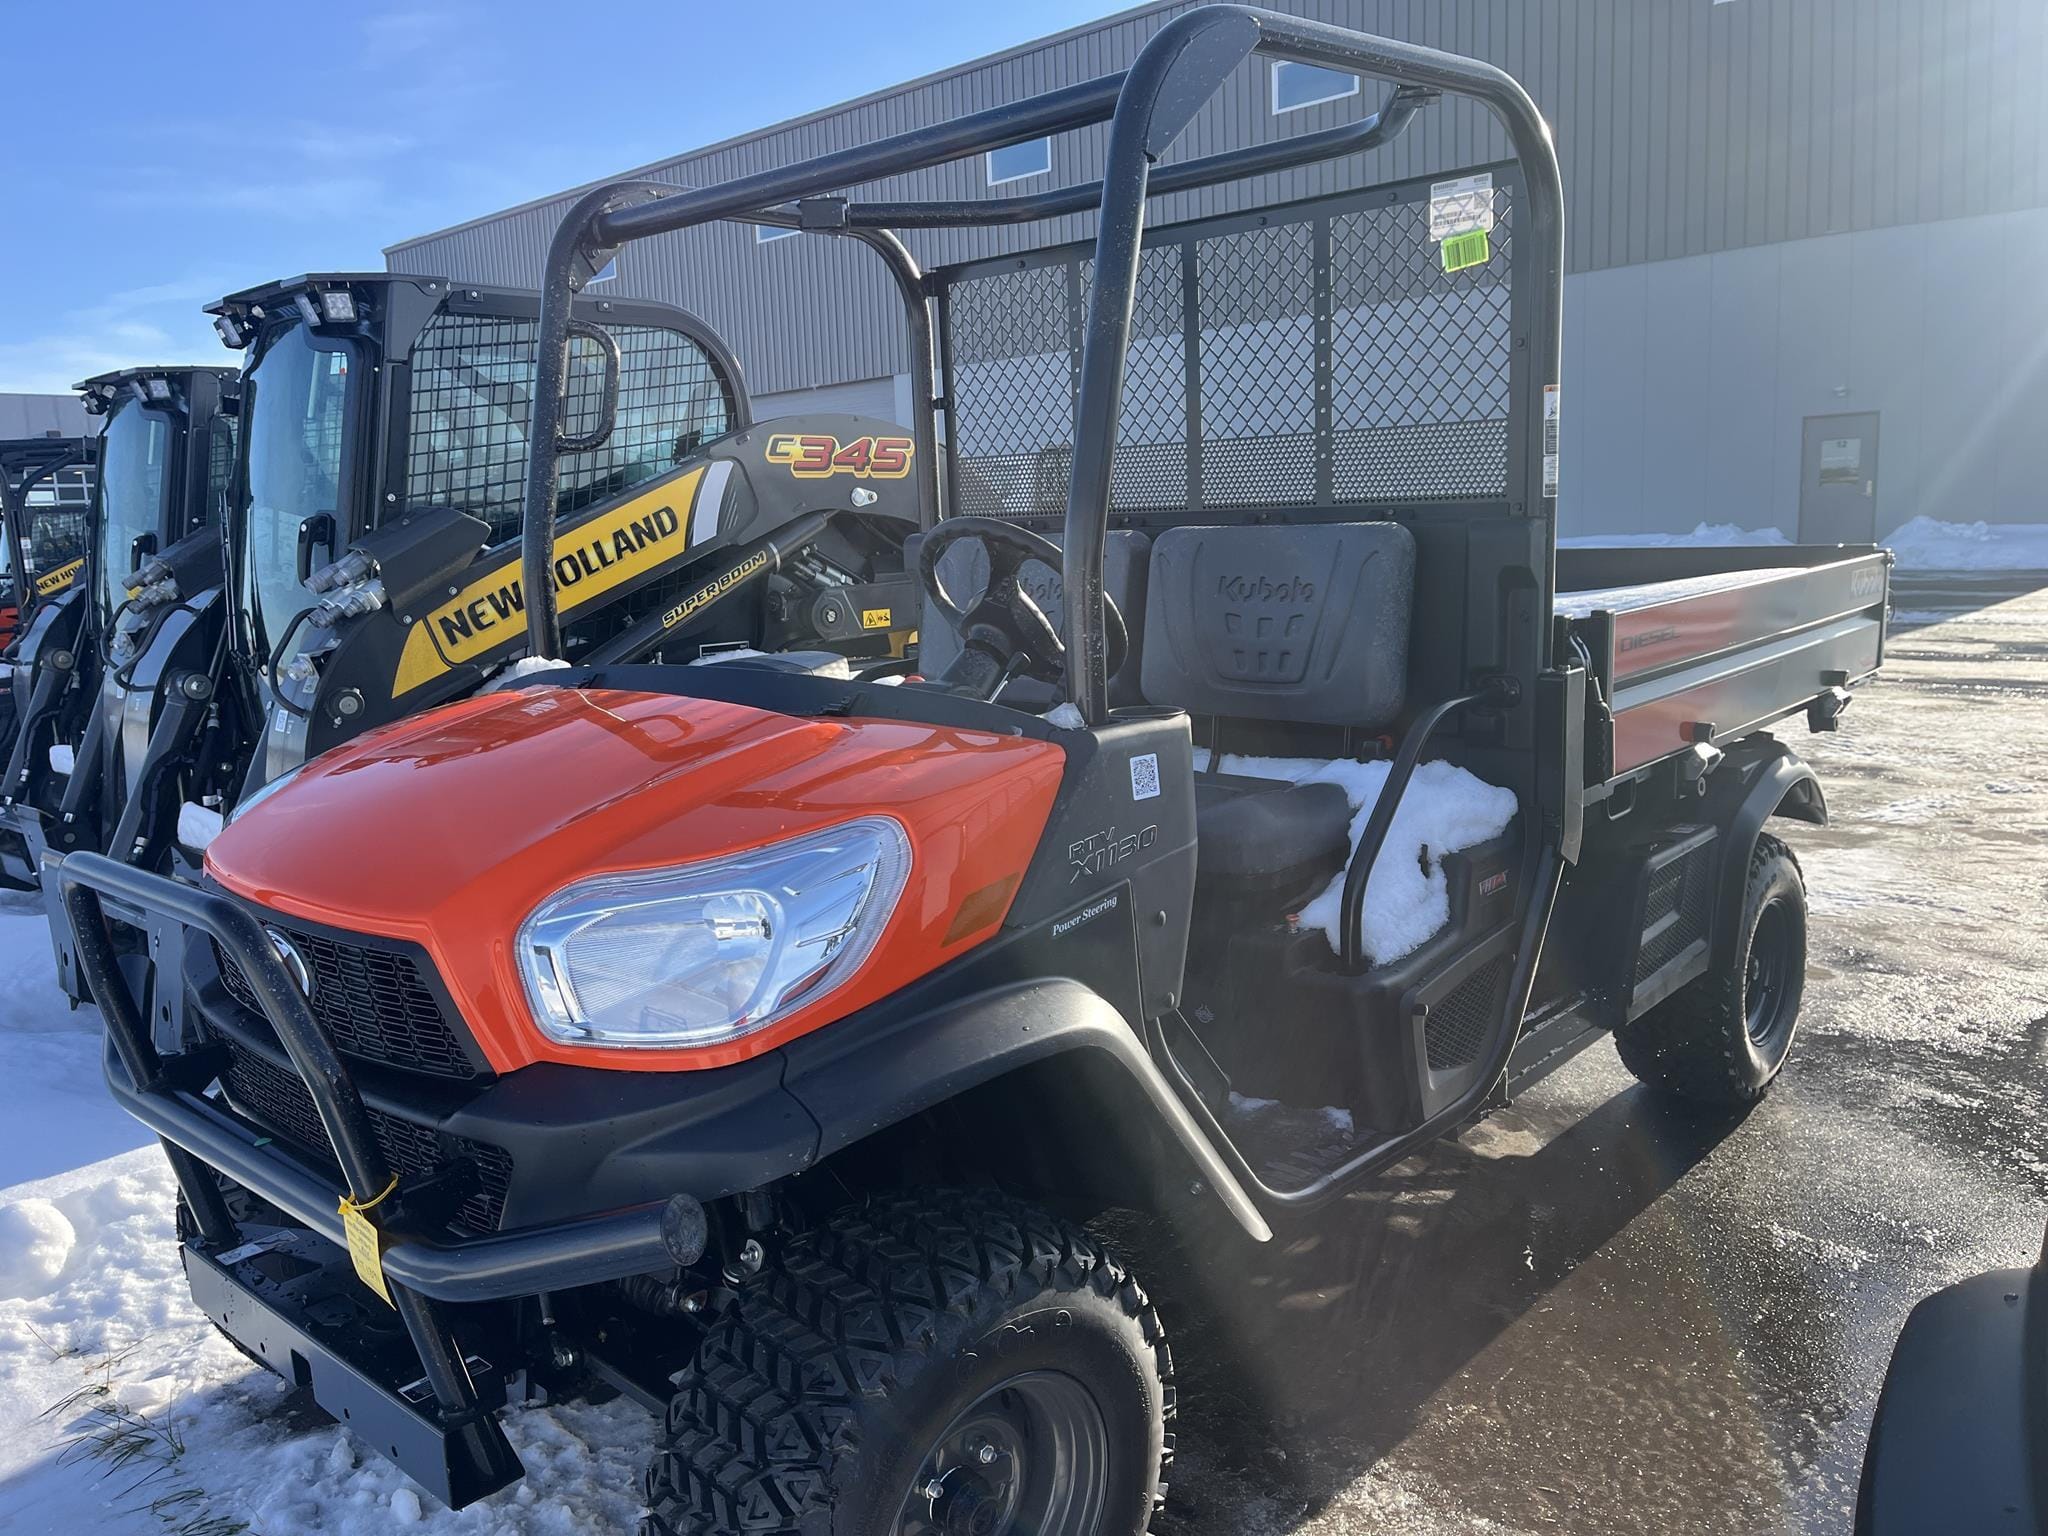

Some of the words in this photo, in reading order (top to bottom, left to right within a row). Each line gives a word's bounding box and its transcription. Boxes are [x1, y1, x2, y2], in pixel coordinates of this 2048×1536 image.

[766, 435, 915, 477] C345
[438, 579, 526, 647] NEW
[553, 506, 679, 593] OLLAND
[663, 584, 720, 628] SUPER
[719, 551, 767, 593] BOOM
[1218, 575, 1314, 602] Kubota
[1620, 626, 1681, 653] DIESEL
[1069, 826, 1115, 860] RTV
[1069, 824, 1158, 884] X1130
[1052, 914, 1081, 937] Power
[1082, 896, 1118, 921] Steering
